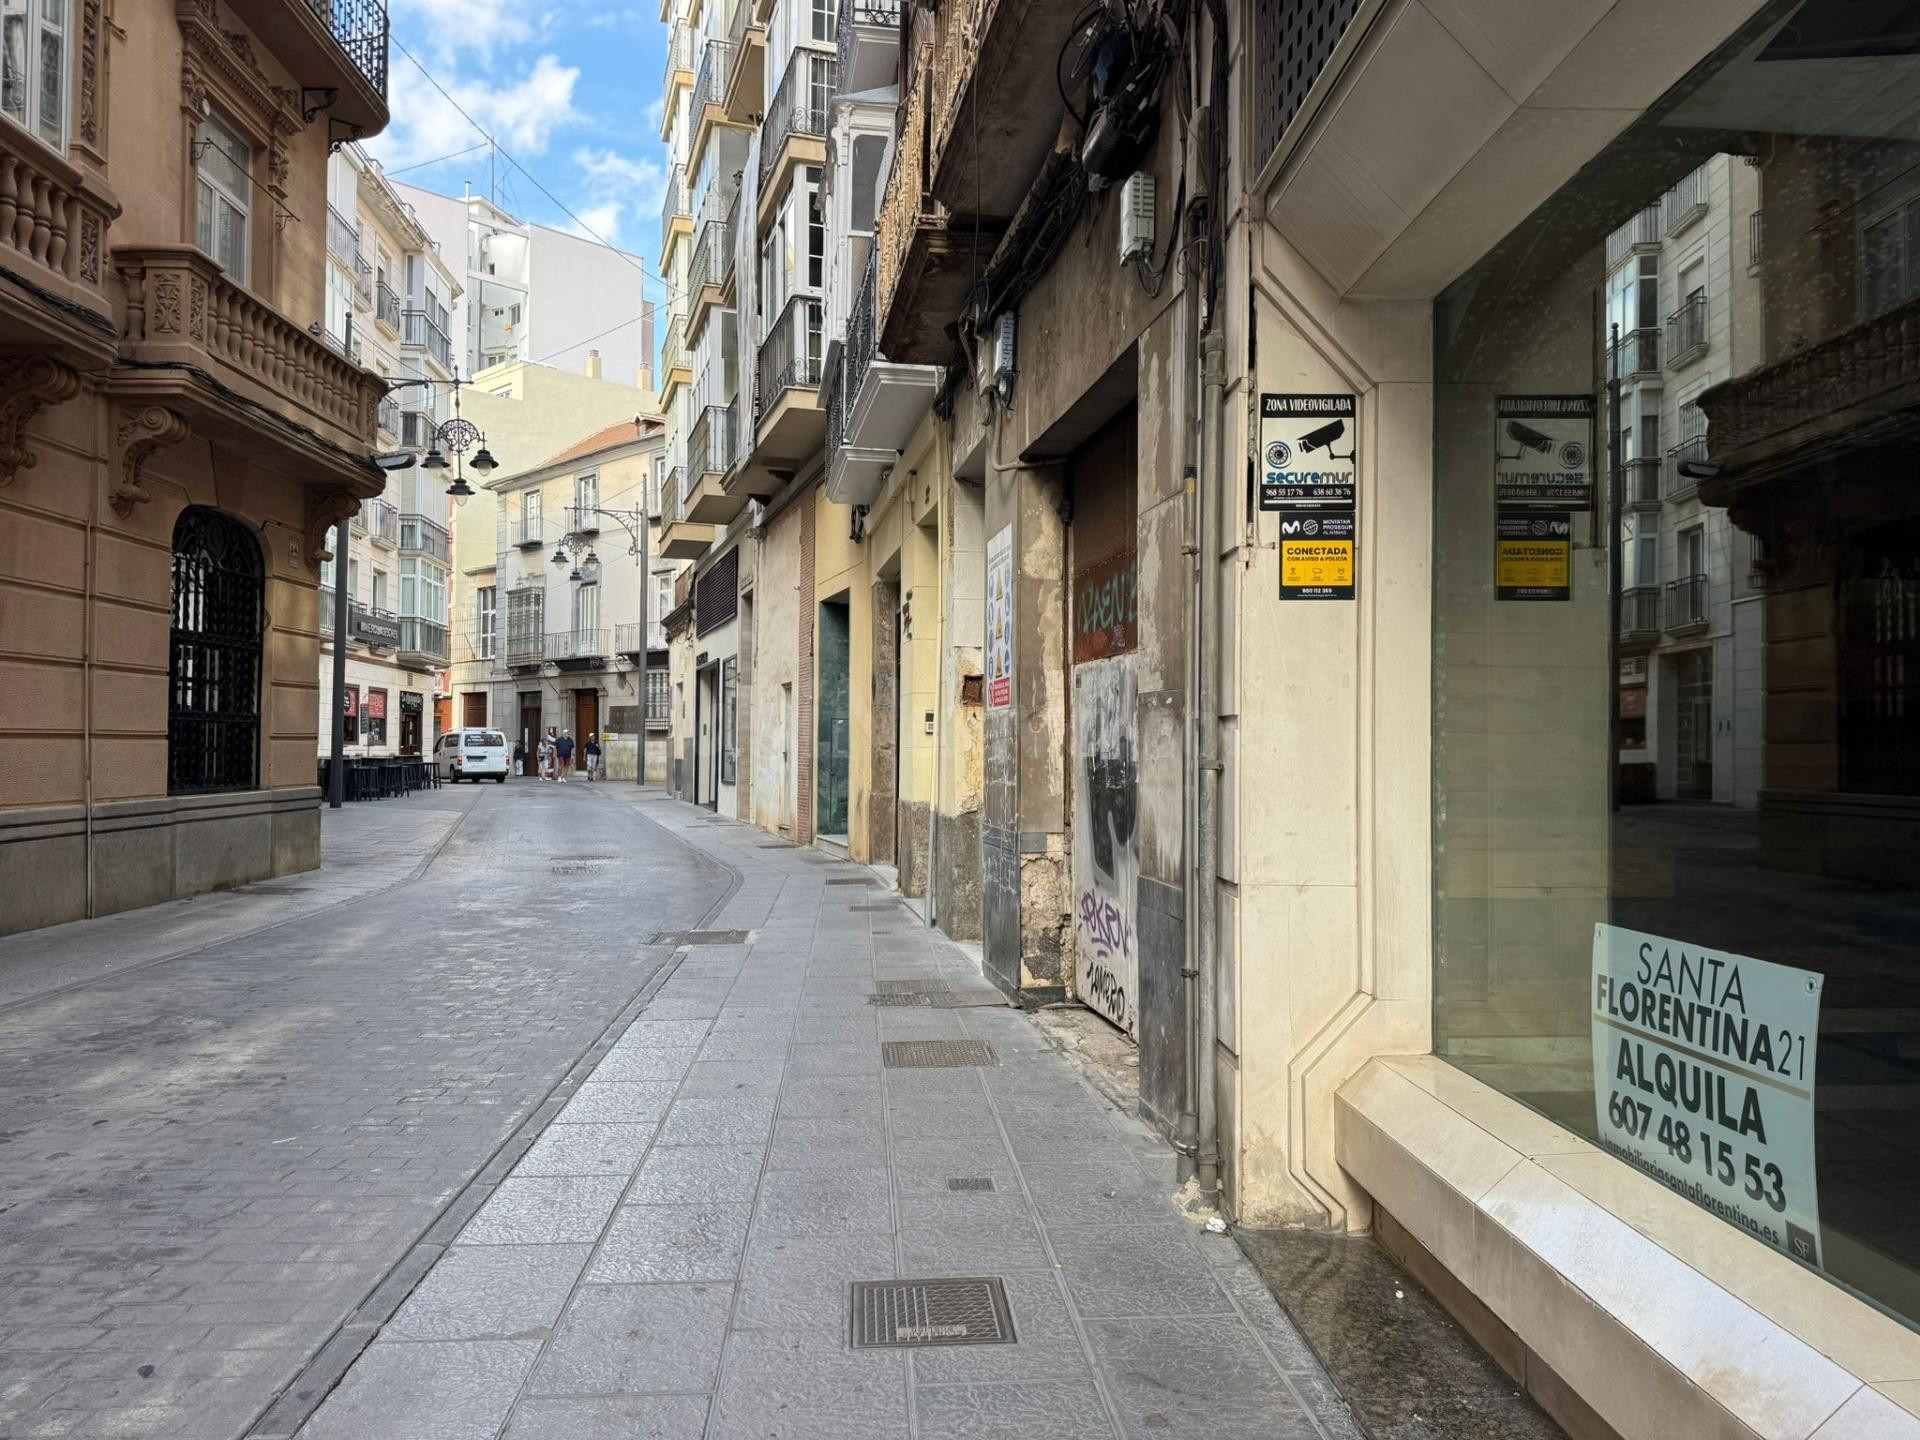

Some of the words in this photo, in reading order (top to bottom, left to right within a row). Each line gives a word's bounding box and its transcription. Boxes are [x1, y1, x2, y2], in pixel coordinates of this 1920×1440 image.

[1266, 398, 1288, 411] ZONA
[1290, 398, 1352, 411] VIDEOVIGILADA
[1266, 471, 1352, 484] securemur
[1287, 547, 1348, 555] CONECTADA
[1637, 942, 1746, 1014] SANTA
[1616, 1037, 1767, 1145] ALQUILA
[1608, 1090, 1653, 1140] 607
[1657, 1113, 1692, 1165] 48
[1700, 1132, 1736, 1187] 15
[1744, 1153, 1787, 1213] 53
